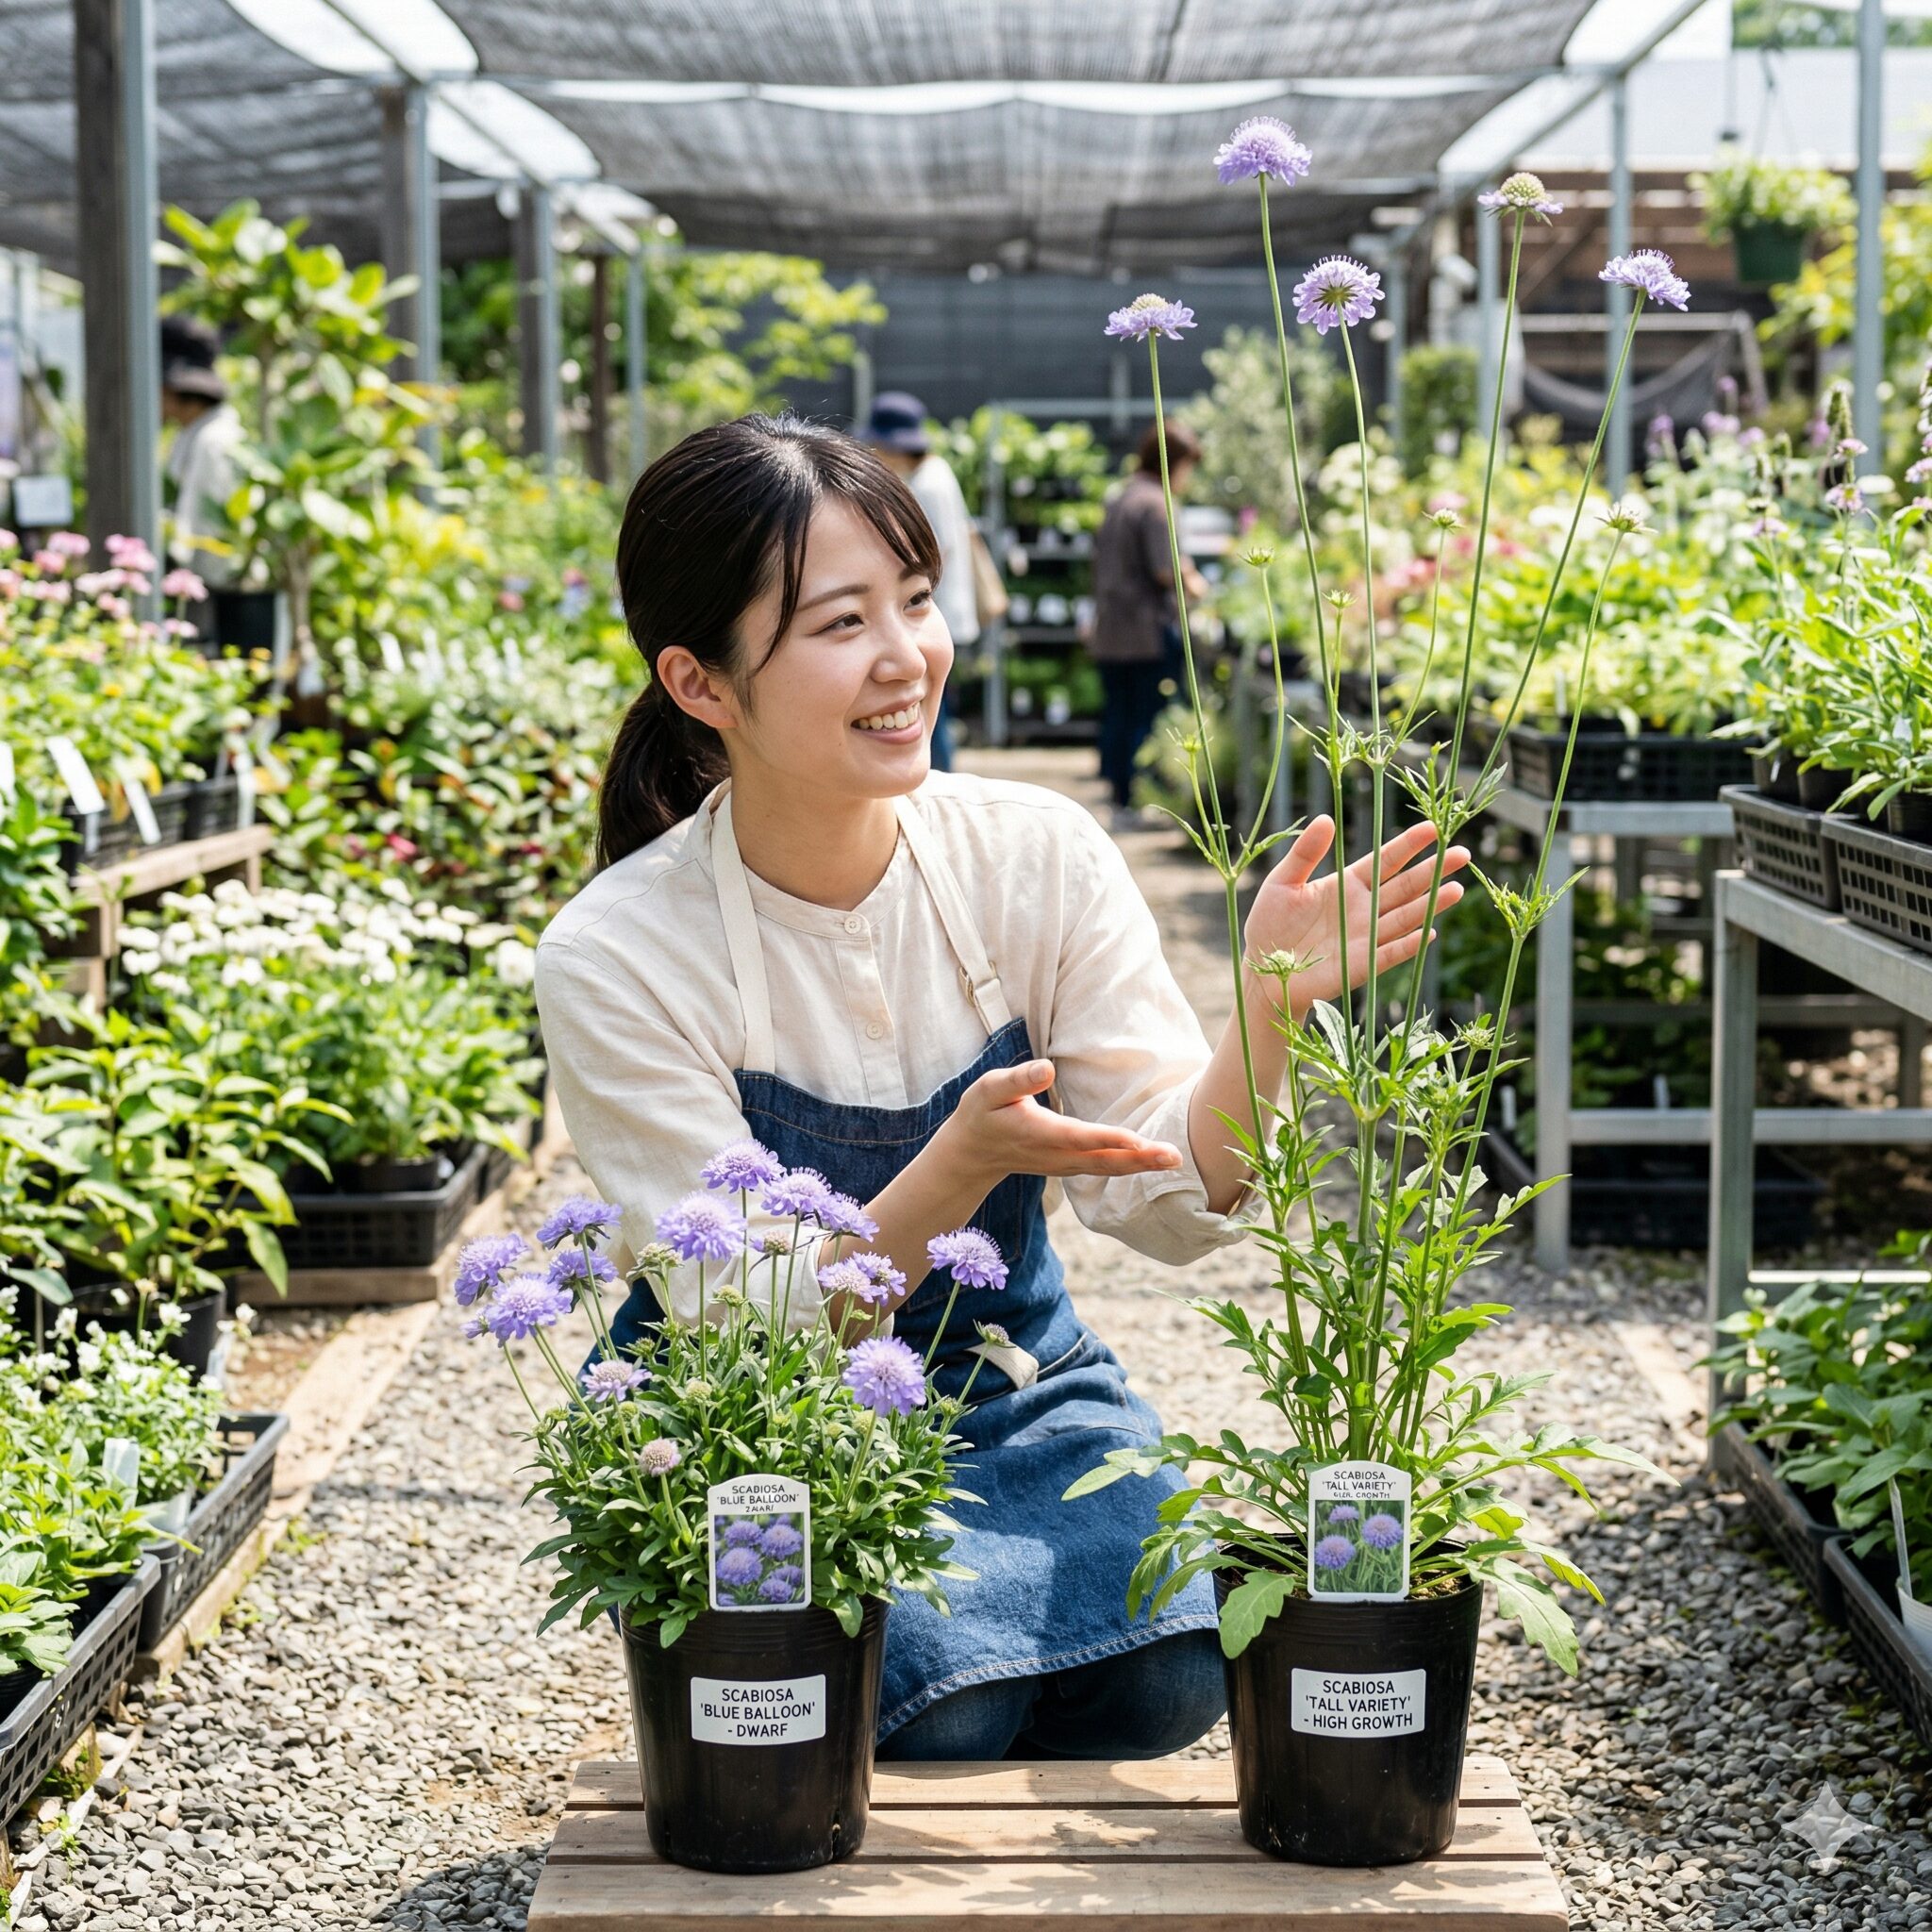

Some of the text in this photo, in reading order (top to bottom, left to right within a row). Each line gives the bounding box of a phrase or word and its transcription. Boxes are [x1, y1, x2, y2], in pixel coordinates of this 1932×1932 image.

[1334, 1471, 1386, 1480] SCABIOSA
[1323, 1679, 1395, 1694] SCABIOSA
[722, 1688, 794, 1703] SCABIOSA
[701, 1701, 815, 1720] 'BLUE BALLOON'
[1306, 1695, 1411, 1712] 'TALL VARIETY'
[1313, 1714, 1347, 1729] HIGH
[1352, 1712, 1413, 1730] GROWTH
[737, 1723, 789, 1738] DWARF
